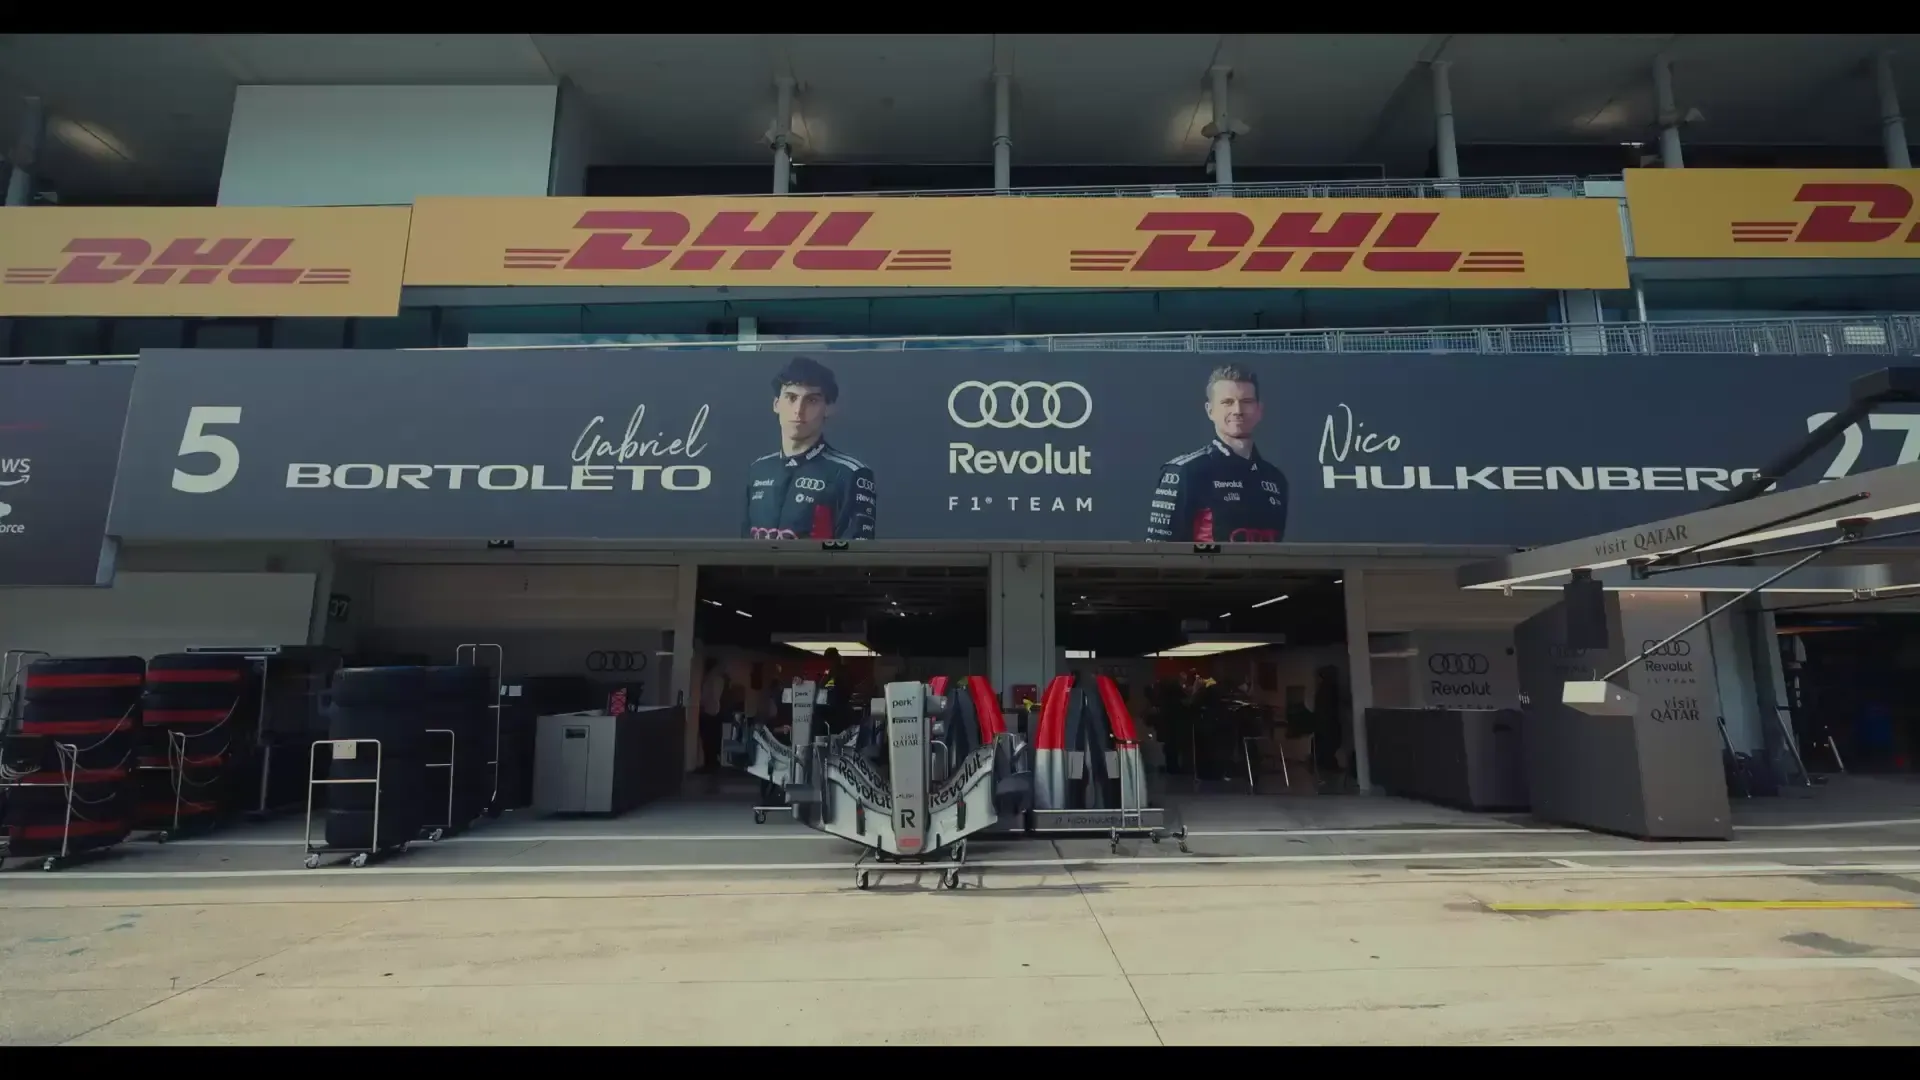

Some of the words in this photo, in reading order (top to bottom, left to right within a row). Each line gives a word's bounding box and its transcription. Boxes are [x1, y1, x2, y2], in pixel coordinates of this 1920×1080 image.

[1794, 183, 1920, 242] D
[48, 237, 305, 285] DHL
[563, 210, 892, 271] DHL
[1131, 211, 1463, 272] DHL
[172, 406, 242, 493] 5
[571, 403, 710, 477] Gabriel
[949, 442, 1092, 475] Revolut
[1318, 402, 1400, 464] Nico
[1806, 411, 1920, 484] 27
[285, 463, 711, 491] BORTOLETO
[1008, 496, 1093, 512] TEAM
[1595, 537, 1627, 557] visit
[1633, 524, 1688, 551] QATAR
[1430, 680, 1493, 697] Revolut
[1644, 660, 1693, 672] Revolut
[1650, 708, 1699, 724] QATAR
[838, 756, 891, 809] Revolut
[930, 752, 983, 809] Revolut
